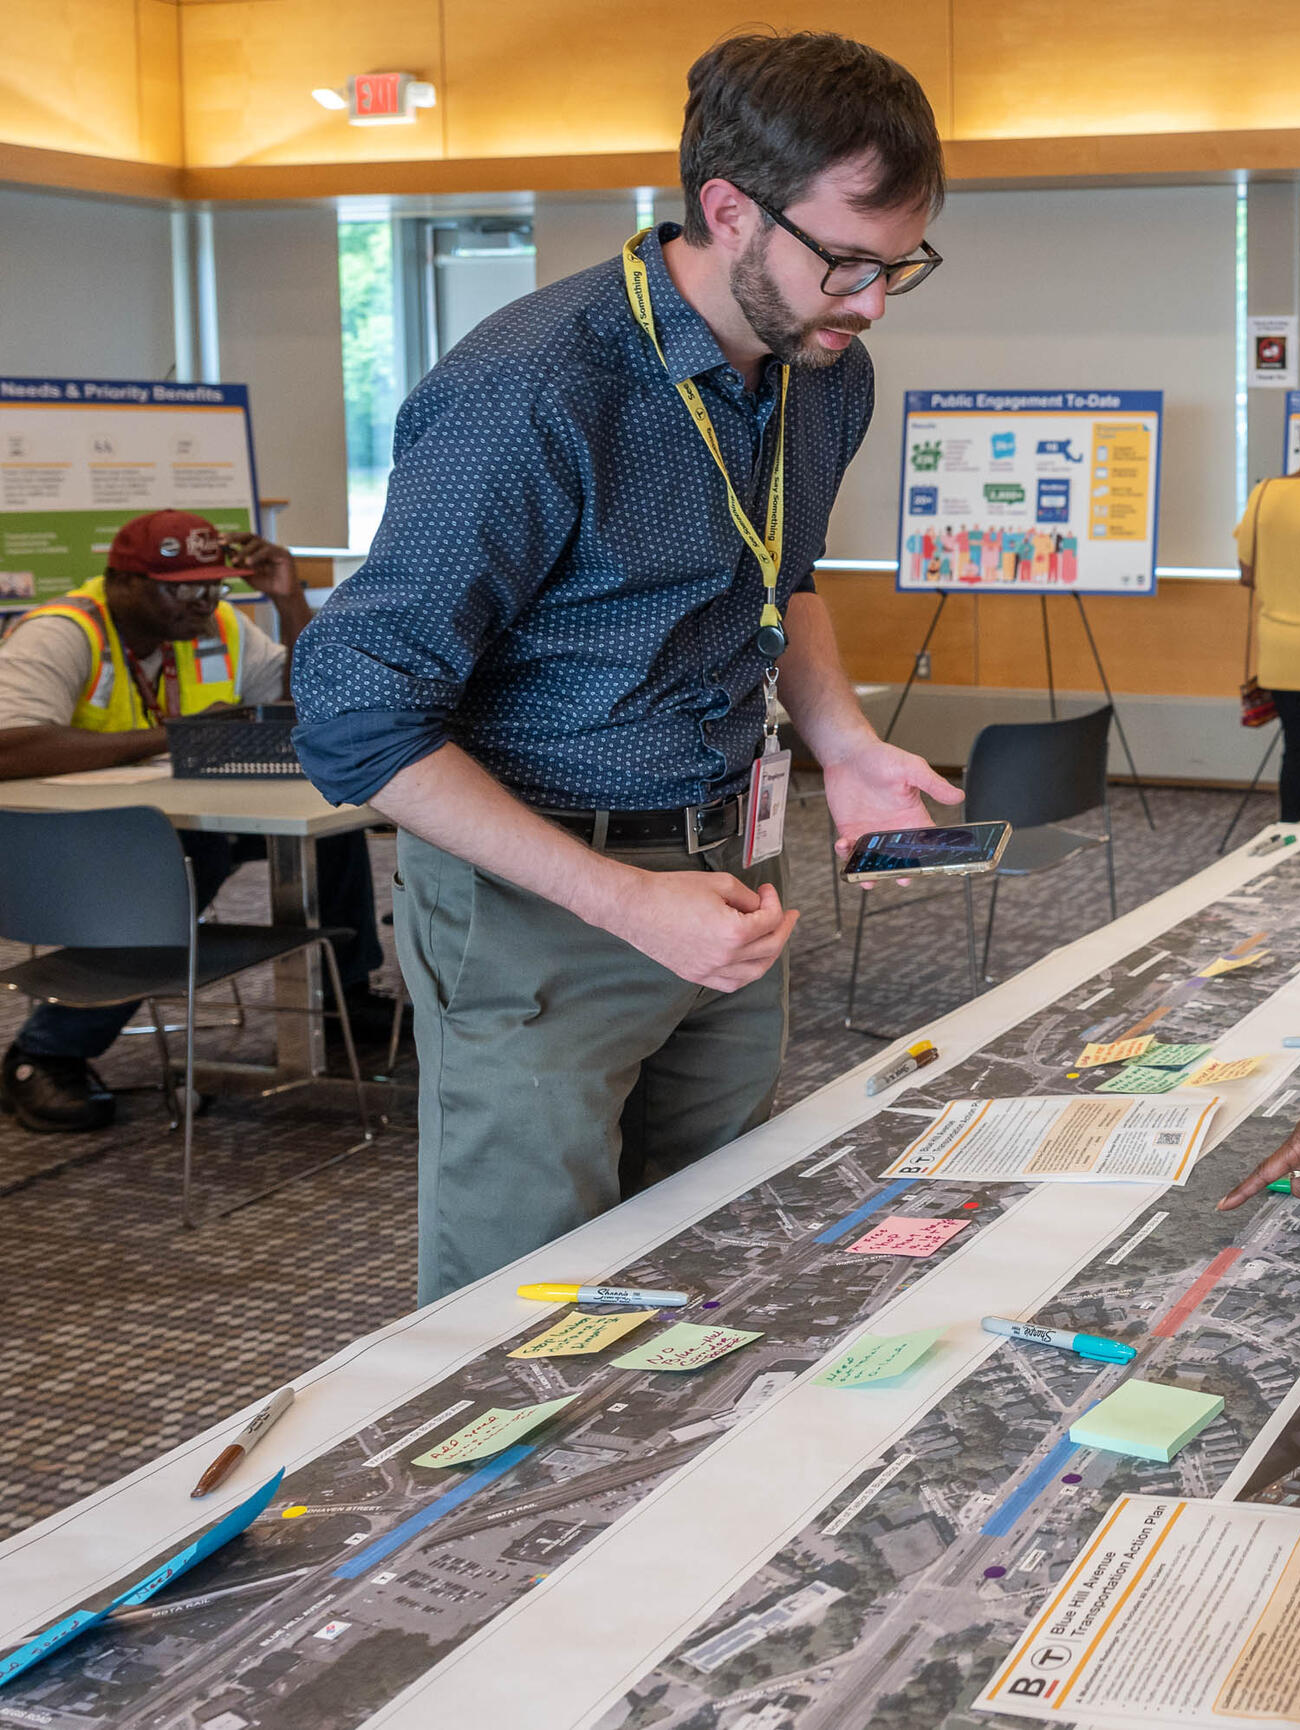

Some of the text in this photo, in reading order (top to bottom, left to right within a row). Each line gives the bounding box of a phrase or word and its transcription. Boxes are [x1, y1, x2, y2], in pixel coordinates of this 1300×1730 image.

[357, 77, 399, 115] EXIT
[1, 382, 224, 403] Needs & Priority Benefits
[931, 394, 1120, 410] Public Engagement To-Date
[768, 495, 779, 541] Something
[1023, 1326, 1056, 1343] Sharpie
[1070, 1504, 1167, 1638] Transportation Action Plan
[1050, 1551, 1116, 1635] Blue Hill Avenue
[1007, 1677, 1047, 1697] B
